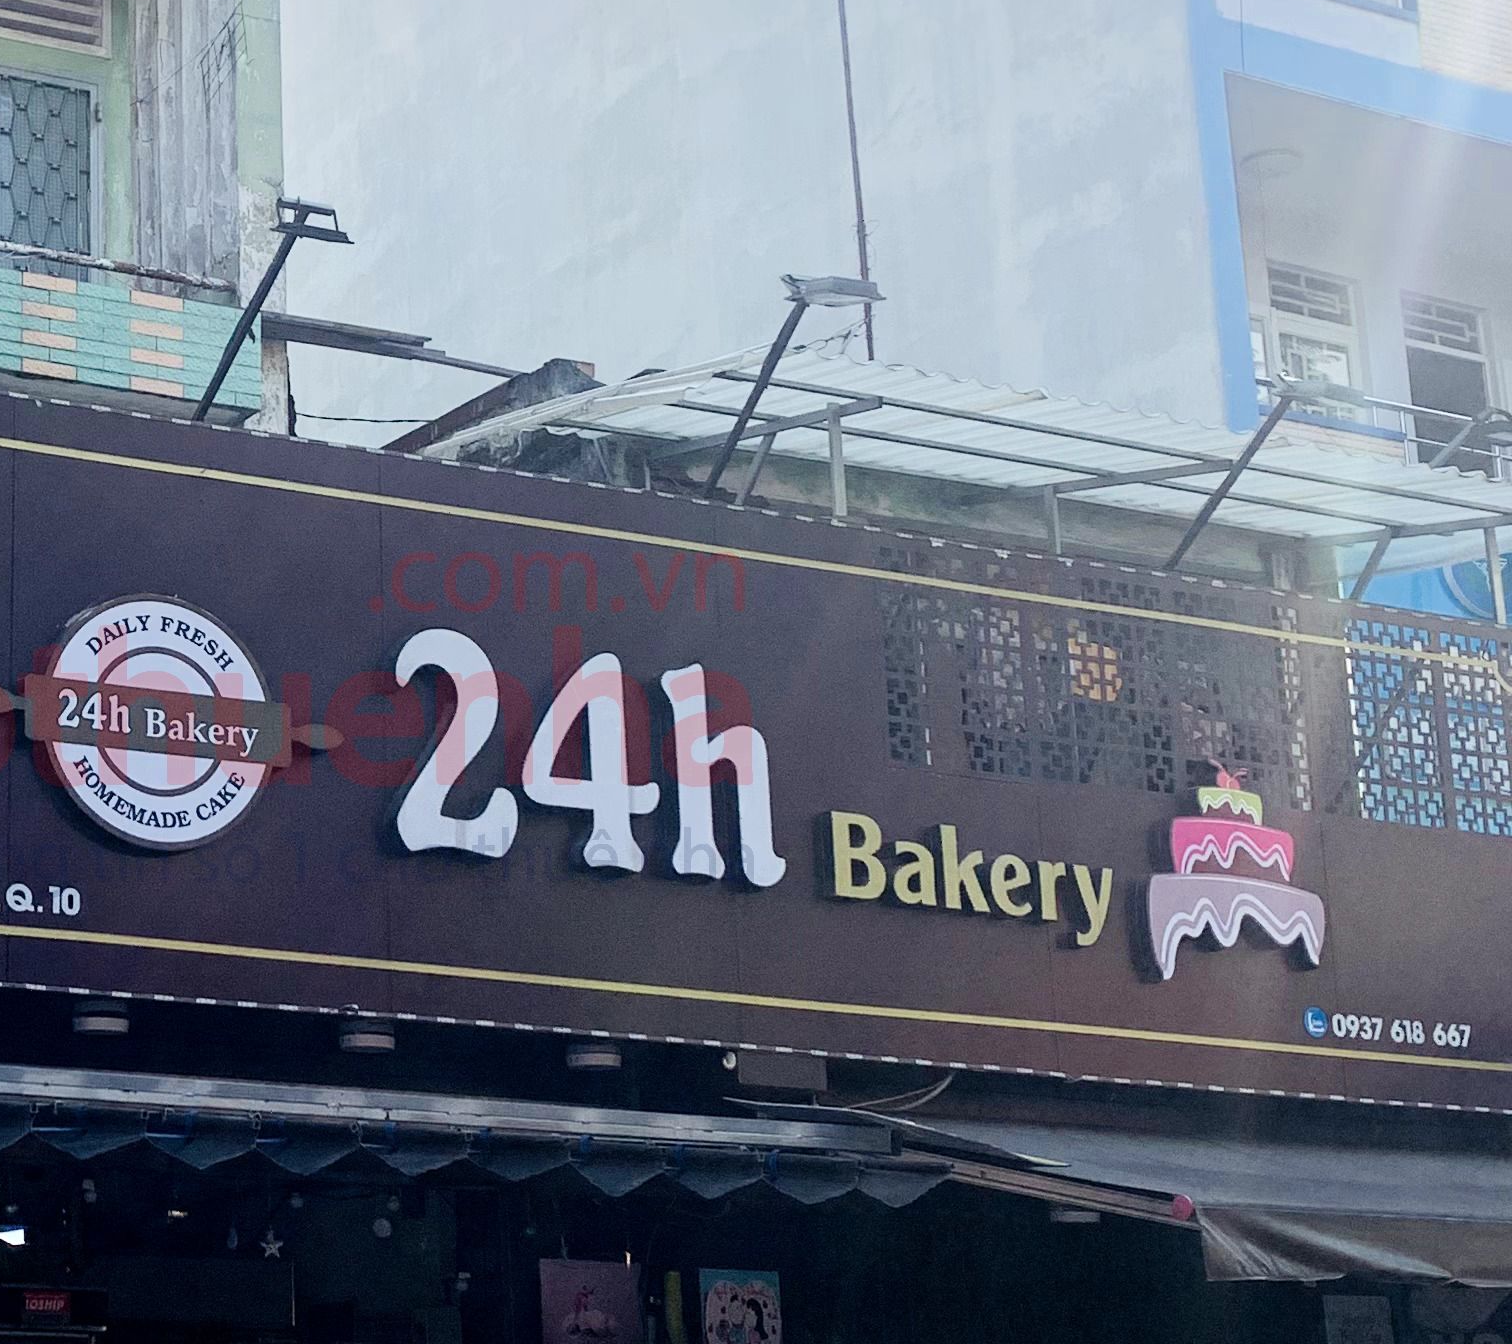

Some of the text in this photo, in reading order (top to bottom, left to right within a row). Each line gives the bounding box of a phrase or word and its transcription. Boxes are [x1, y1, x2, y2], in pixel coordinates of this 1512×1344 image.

[85, 614, 235, 672] DAILY FRESH
[57, 687, 260, 758] 24h Bakery
[394, 627, 787, 890] 24h
[72, 754, 246, 829] HOMEMADE CAKE
[827, 810, 1115, 948] Bakery
[1331, 1013, 1471, 1048] 0937 618 667
